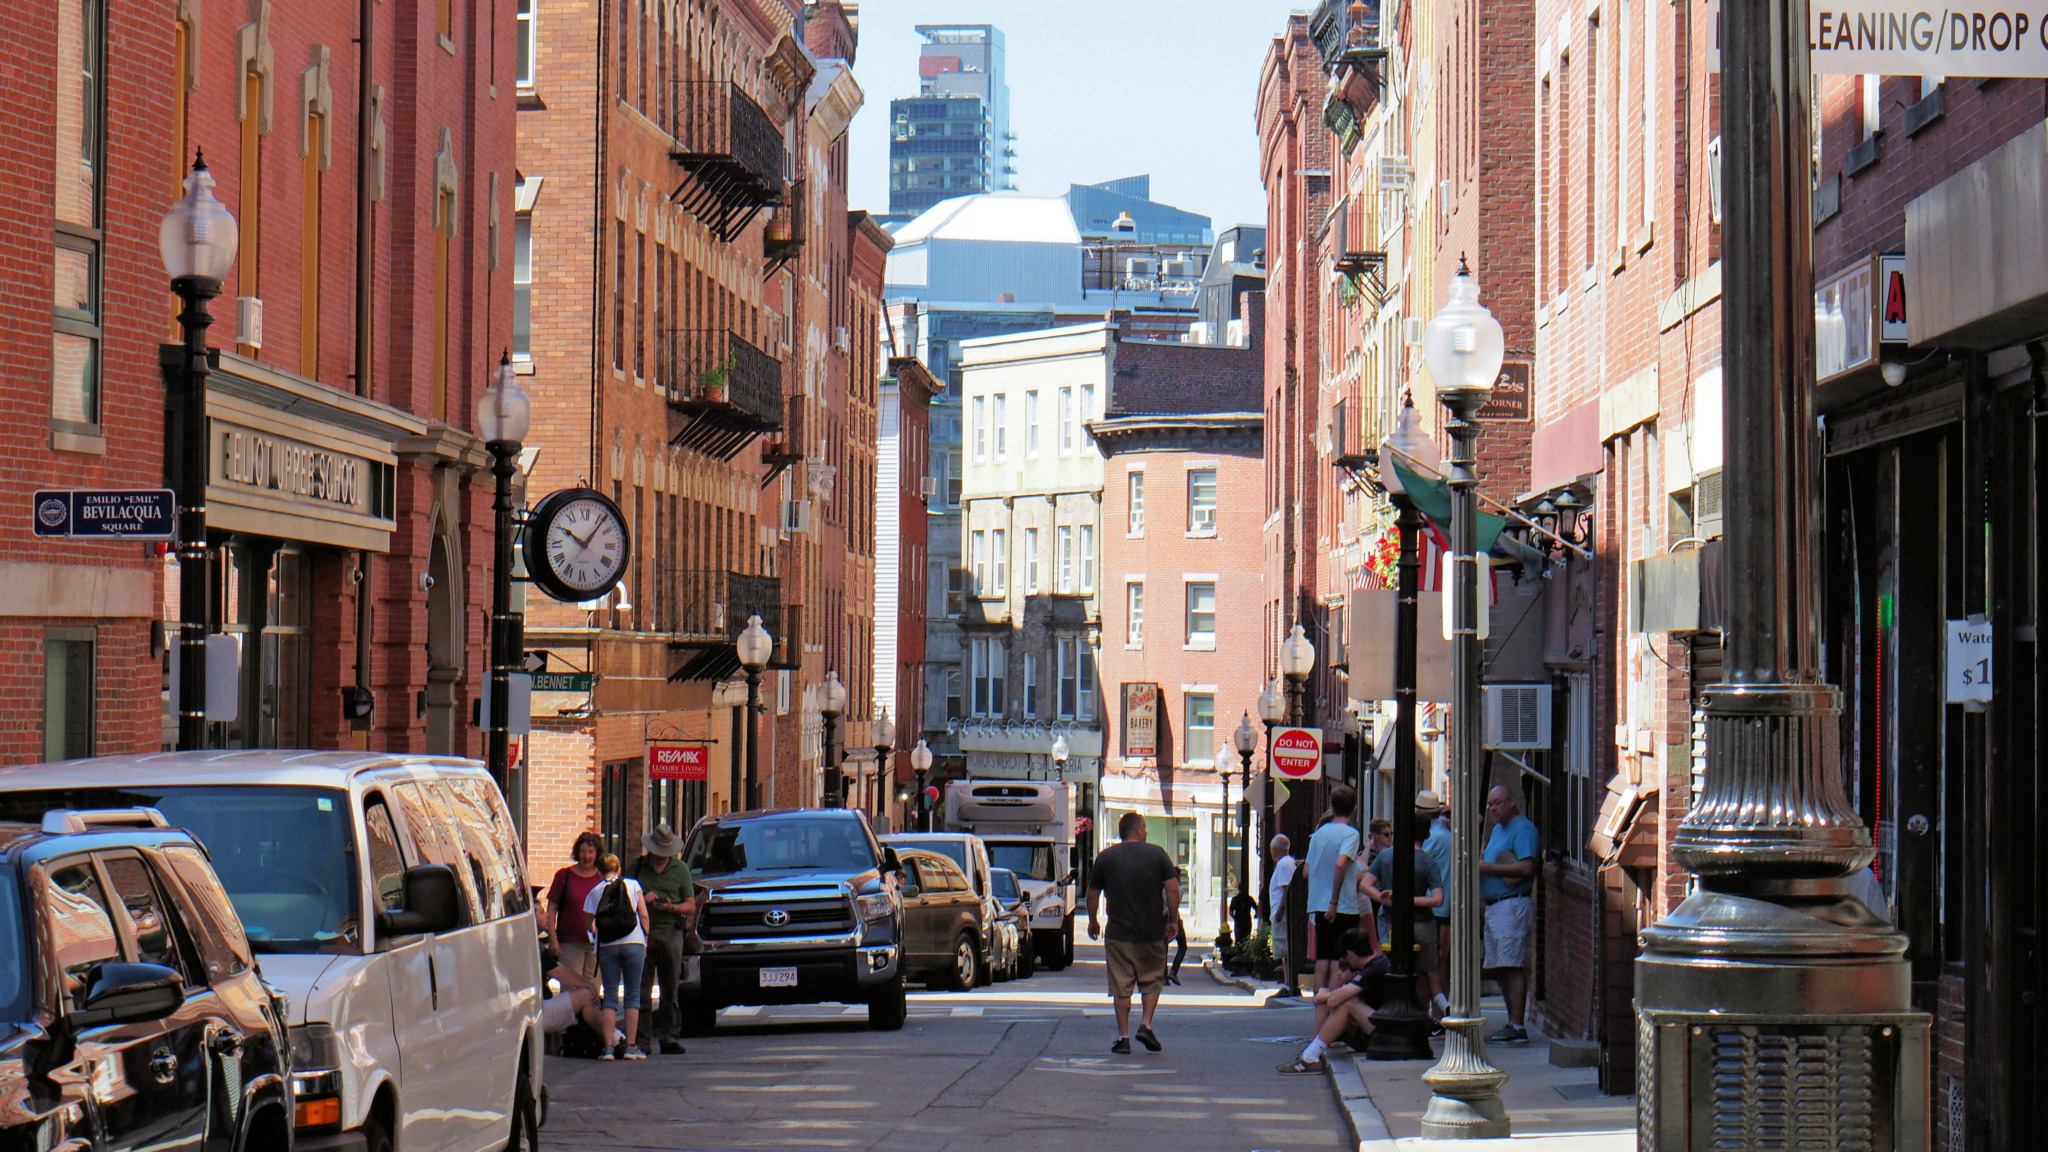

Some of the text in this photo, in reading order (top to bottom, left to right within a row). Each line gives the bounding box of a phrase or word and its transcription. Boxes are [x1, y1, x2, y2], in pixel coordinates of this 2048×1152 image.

[234, 432, 361, 505] ELIOT UPPER SCHOOL
[86, 495, 121, 504] EMILIO
[83, 505, 162, 522] BEVILACQUA
[101, 523, 143, 532] SQUARE
[580, 681, 589, 690] ST
[1130, 718, 1153, 729] BAKERY
[1279, 738, 1314, 748] DO NOT
[657, 749, 700, 763] RE/MAX
[1037, 756, 1083, 773] SALUERIA
[1281, 757, 1310, 767] ENTER
[652, 763, 706, 772] LUXURY LIVING
